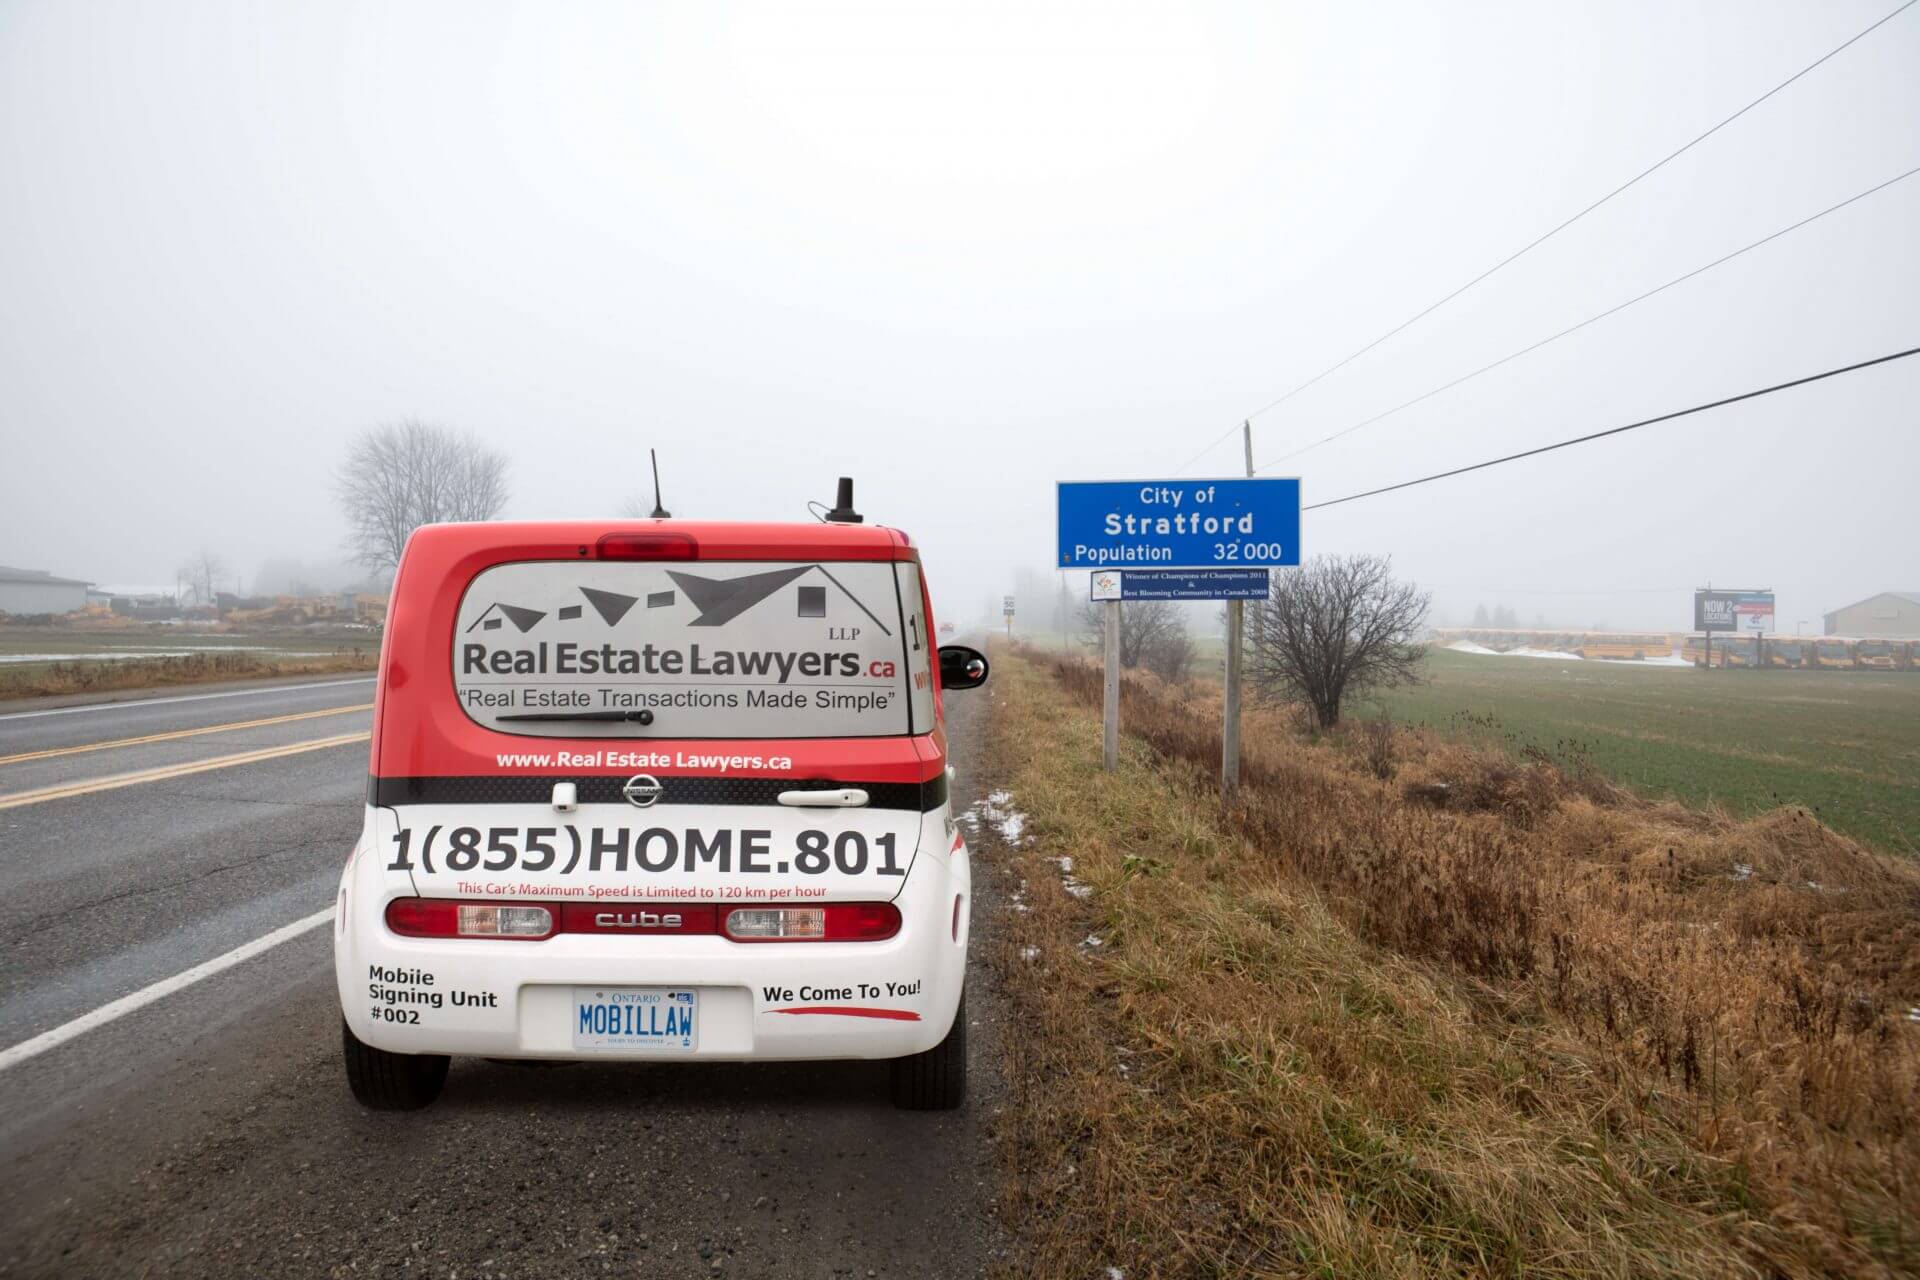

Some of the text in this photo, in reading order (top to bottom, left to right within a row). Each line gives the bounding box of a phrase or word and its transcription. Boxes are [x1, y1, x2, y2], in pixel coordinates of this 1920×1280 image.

[1140, 486, 1215, 507] City of
[1104, 513, 1253, 535] Stratford
[1075, 545, 1172, 564] Population
[1161, 573, 1199, 581] Champions
[1200, 572, 1208, 580] of
[1209, 572, 1248, 580] Champions
[1139, 589, 1172, 598] Blooming
[1173, 589, 1213, 598] Community
[1214, 588, 1222, 596] in
[1223, 588, 1249, 596] Canada
[1704, 600, 1725, 613] NOW
[1727, 600, 1733, 613] 2
[829, 627, 861, 641] LLP
[523, 689, 591, 707] Estate
[598, 688, 739, 709] Transactions
[746, 690, 808, 709] Made
[606, 752, 671, 768] Estate
[676, 753, 792, 772] Lawyers.ca
[387, 825, 905, 877] 1(855)HOME.801
[457, 882, 827, 900] This Car’s Maximum Speed is Limited to 120 km per hour
[595, 911, 682, 928] cube
[368, 983, 498, 1009] Signing Unit
[612, 993, 661, 1004] ONTARIO
[763, 979, 921, 1002] We Come To You!
[371, 1005, 420, 1025] #002
[579, 1004, 692, 1036] MOBILLAW
